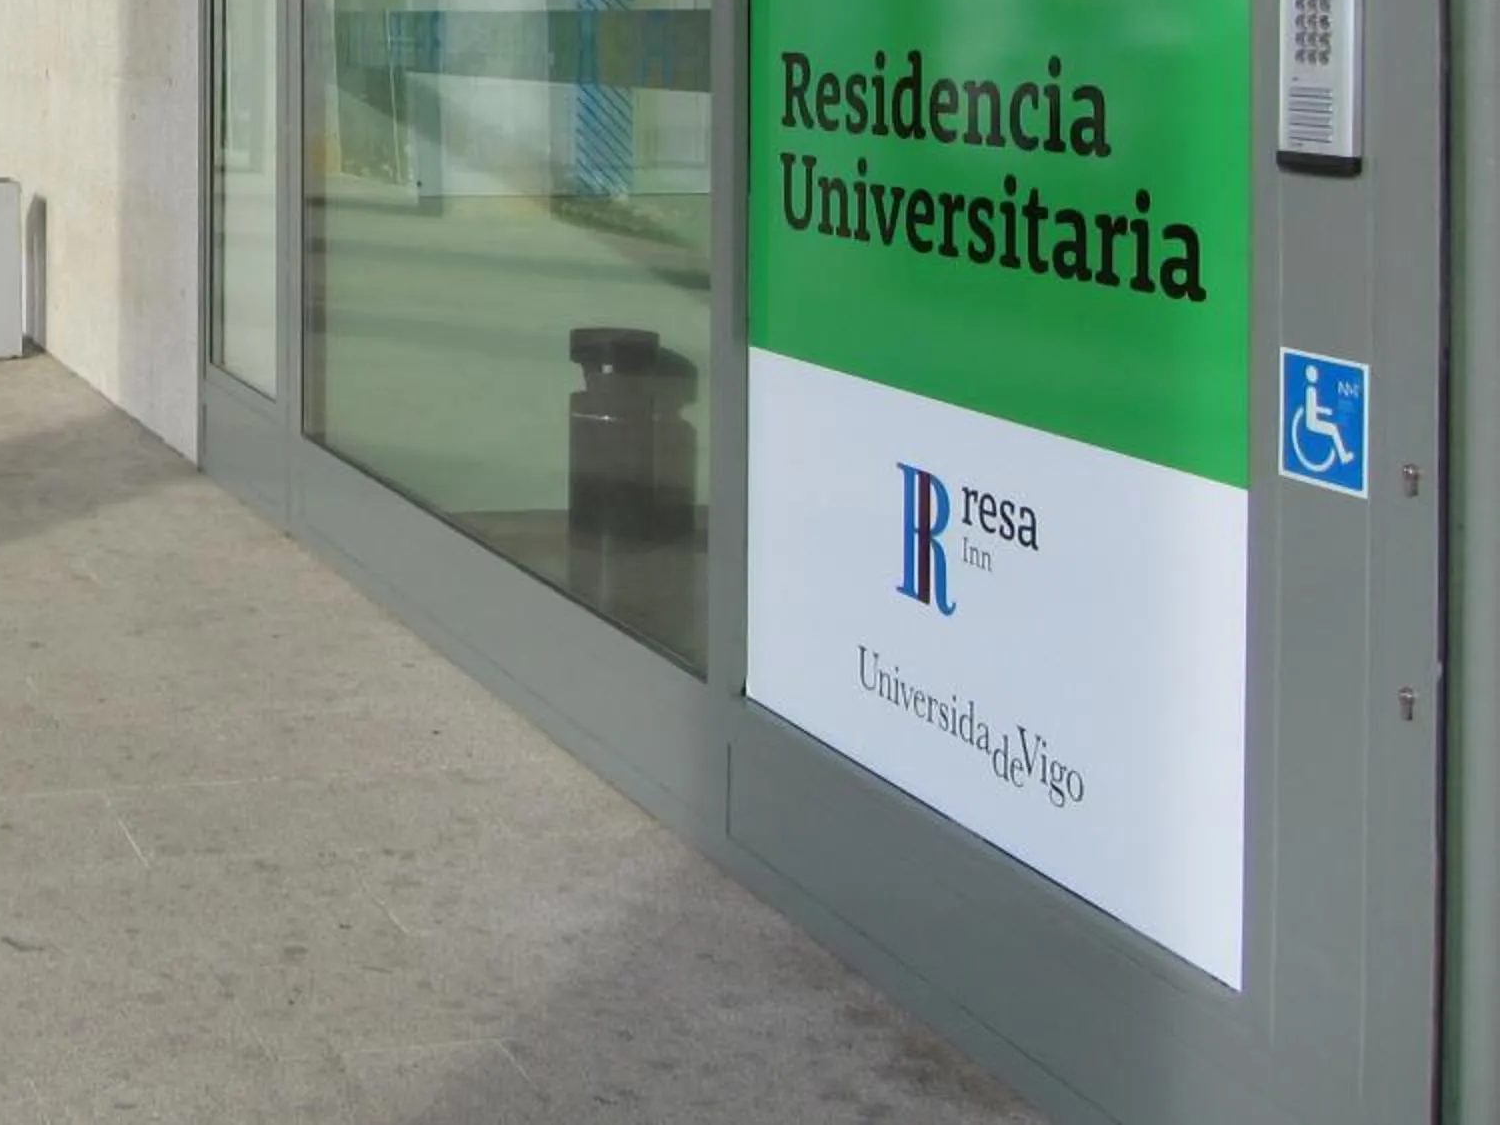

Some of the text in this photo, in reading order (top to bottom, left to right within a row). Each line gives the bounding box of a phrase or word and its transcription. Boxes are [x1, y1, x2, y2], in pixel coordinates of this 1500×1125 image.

[781, 49, 1111, 158] Residencia
[780, 151, 1207, 302] Universitaria
[961, 483, 1039, 550] resa
[961, 537, 993, 572] Inn
